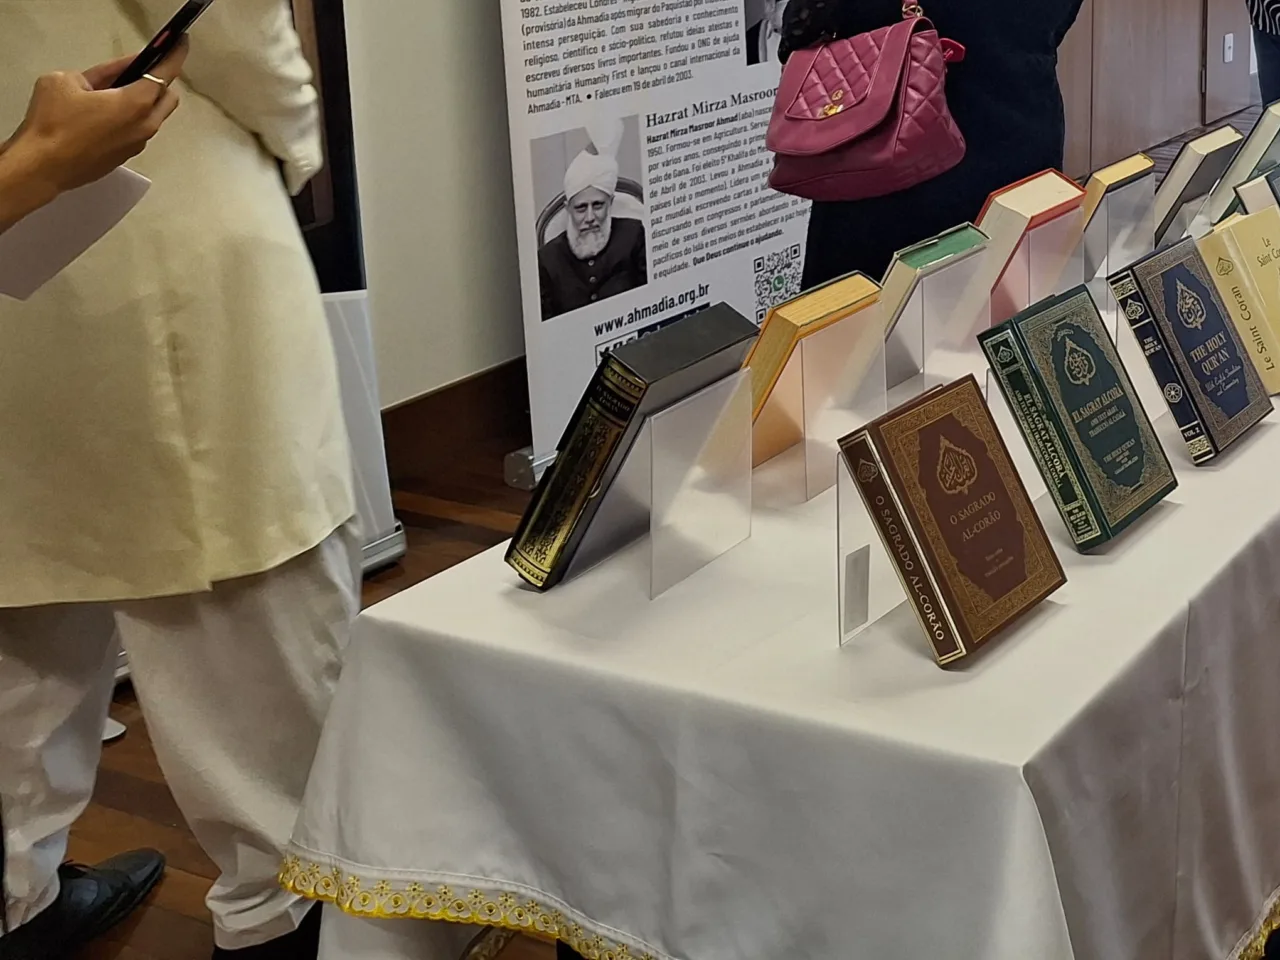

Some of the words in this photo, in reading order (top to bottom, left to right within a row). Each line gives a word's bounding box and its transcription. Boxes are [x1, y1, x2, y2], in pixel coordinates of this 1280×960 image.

[646, 107, 688, 128] Hazrat
[692, 100, 727, 116] Mirza
[731, 86, 779, 107] Masroor
[1261, 237, 1271, 248] Le
[1256, 253, 1272, 267] Saint
[594, 283, 710, 337] www.ahmadia.org.br
[1231, 286, 1252, 321] Coran
[1190, 344, 1208, 363] THE
[1205, 331, 1227, 352] HOLY
[1249, 326, 1267, 354] Saint
[1262, 357, 1275, 371] Le
[1023, 393, 1033, 406] EL
[1029, 406, 1050, 440] SAGRAT
[1070, 408, 1082, 424] EL
[949, 515, 958, 525] O
[958, 491, 996, 521] SAGRADO
[962, 510, 1001, 542] AL-CORÃO
[874, 495, 885, 506] O
[881, 509, 914, 571] SAGRADO
[910, 576, 944, 640] AL-CORÃO
